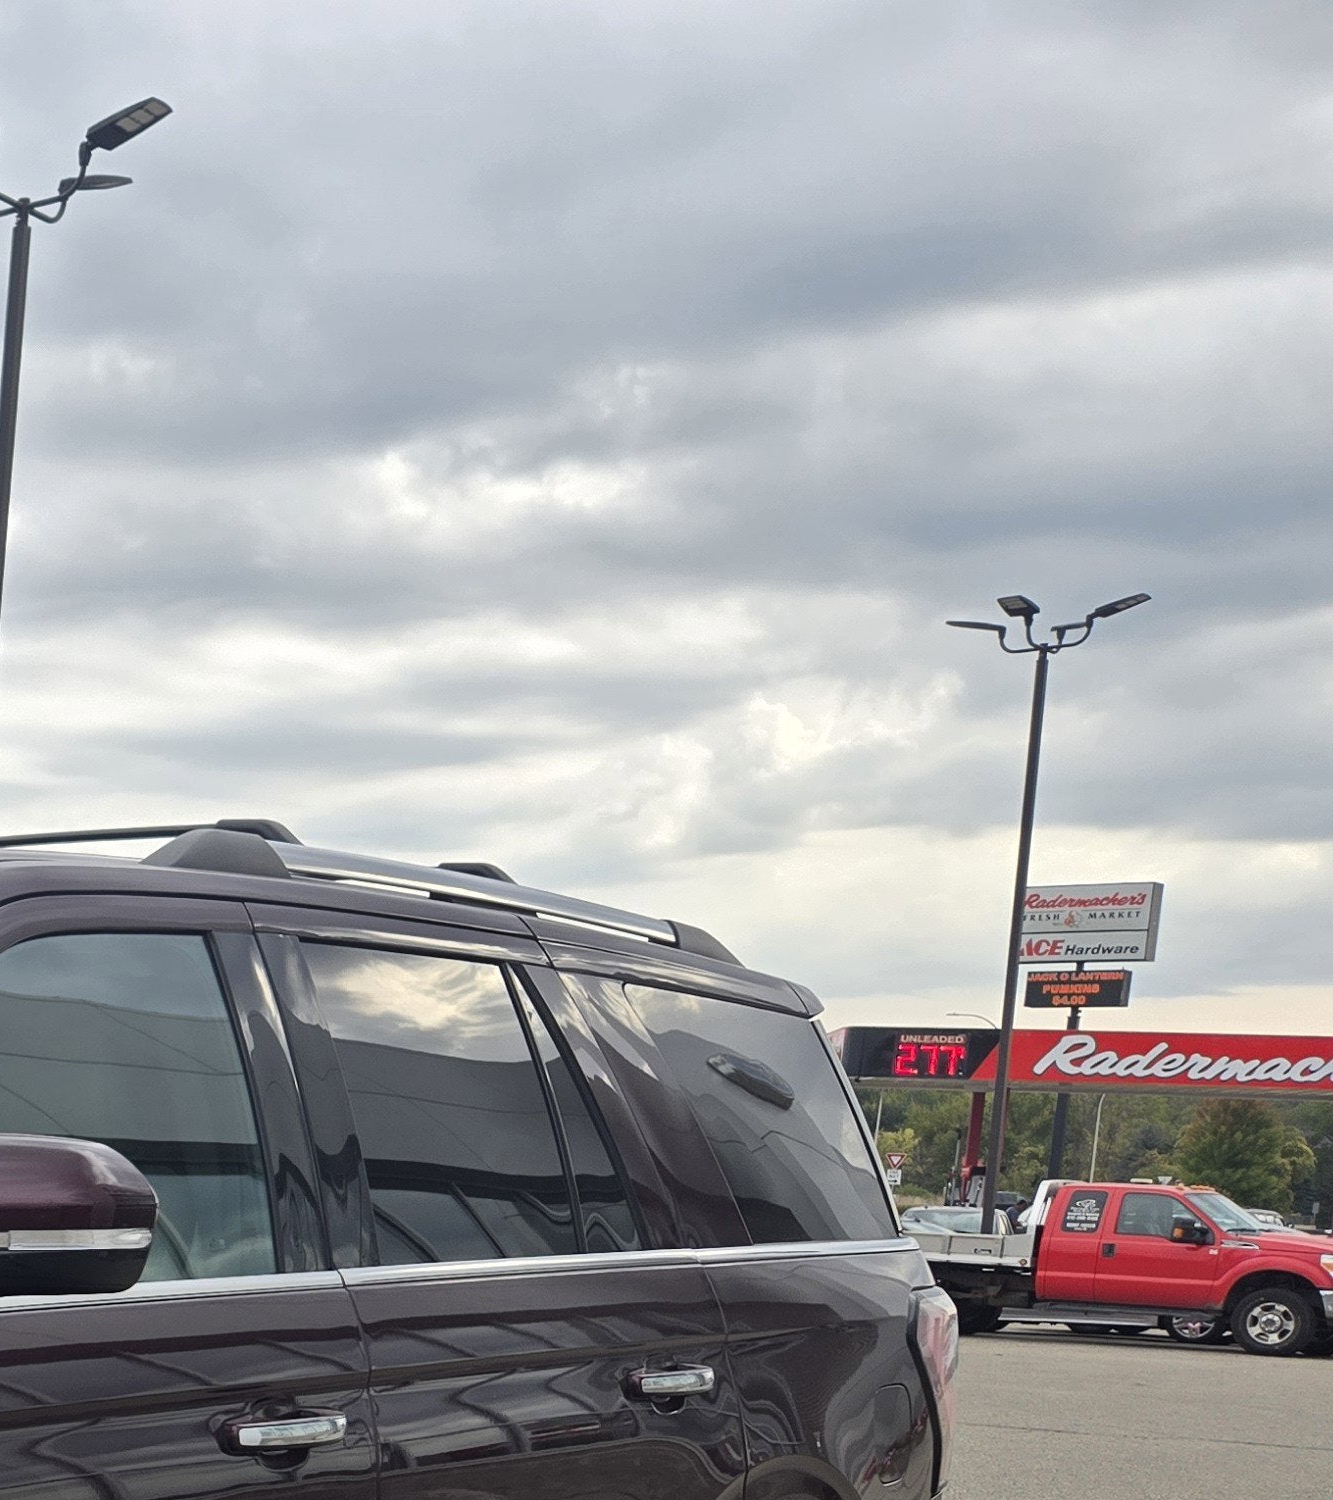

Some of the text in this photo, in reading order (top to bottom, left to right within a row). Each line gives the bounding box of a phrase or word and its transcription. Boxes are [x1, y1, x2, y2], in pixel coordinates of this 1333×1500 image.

[1024, 892, 1147, 909] Radermacher's
[1088, 910, 1142, 920] MARKET
[1019, 938, 1140, 957] ACE Hardware
[900, 1034, 965, 1044] UNLEADED
